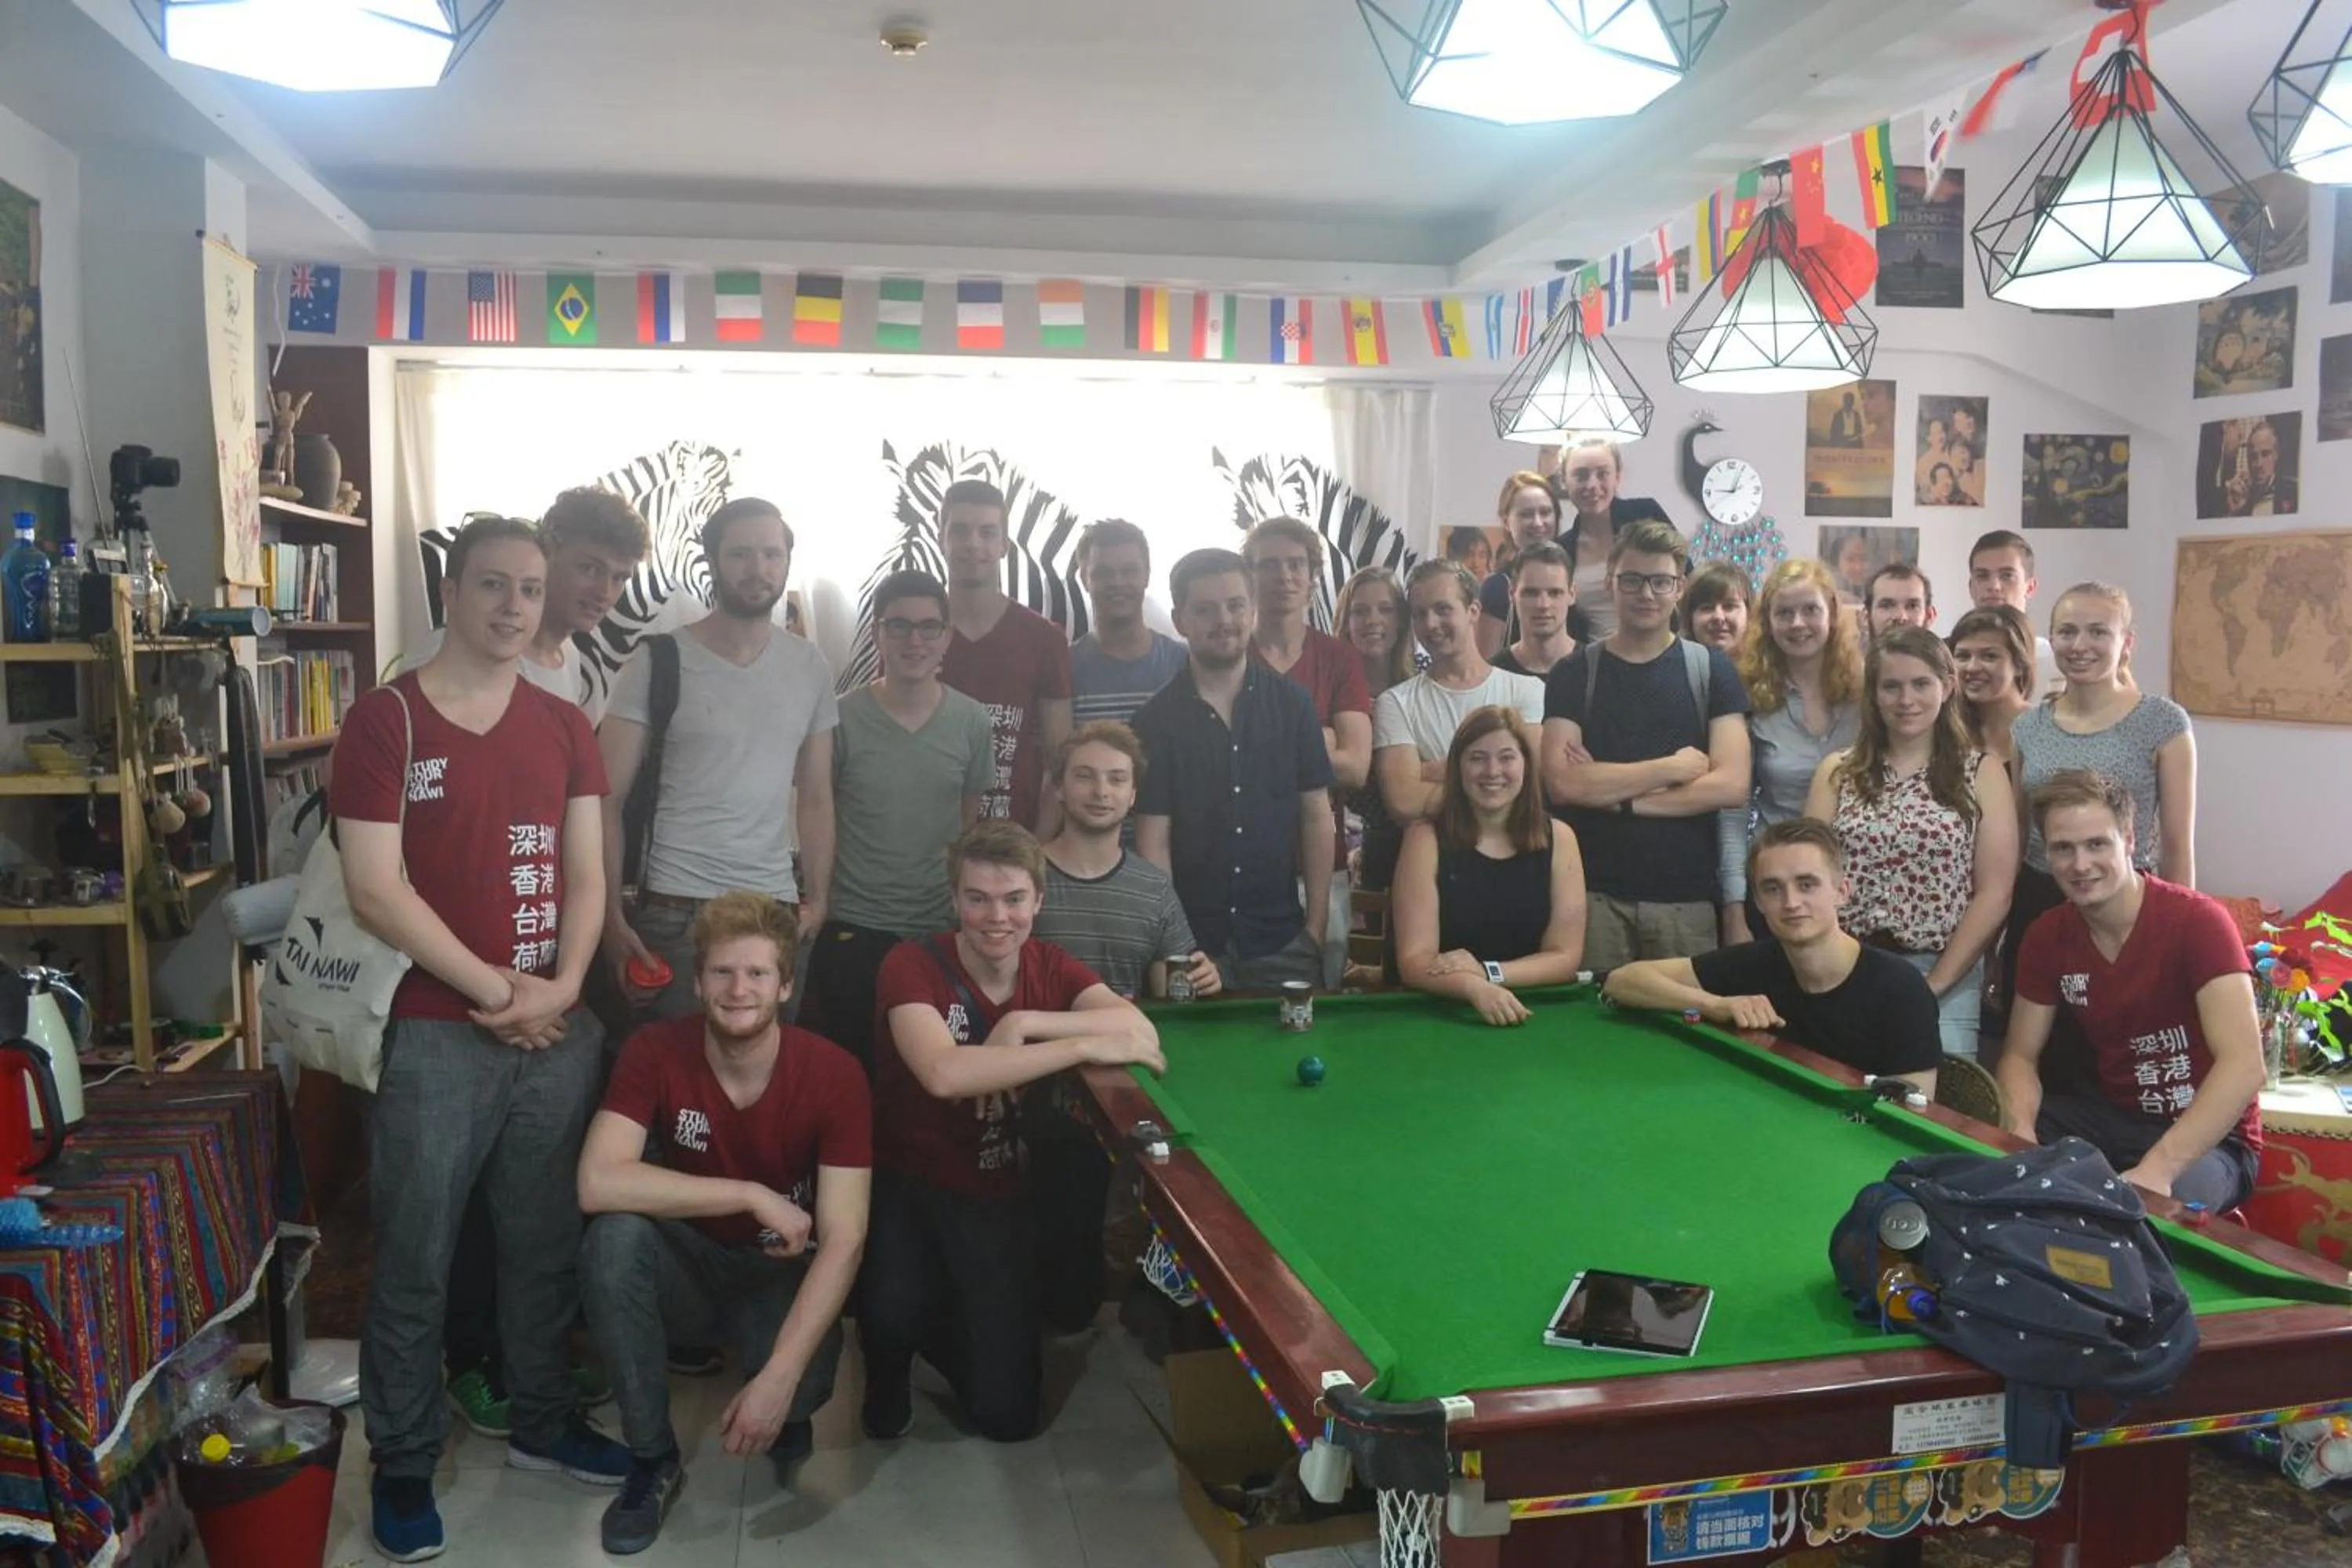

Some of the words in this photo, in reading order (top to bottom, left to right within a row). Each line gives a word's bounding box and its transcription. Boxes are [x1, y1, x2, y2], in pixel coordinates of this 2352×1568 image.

[412, 757, 448, 771] TUDY
[508, 823, 556, 856] 深圳
[510, 864, 554, 897] 香港
[286, 937, 310, 972] TAI
[309, 955, 361, 985] NAWI
[2130, 1025, 2188, 1055] 深圳
[2134, 1054, 2191, 1086] 香港
